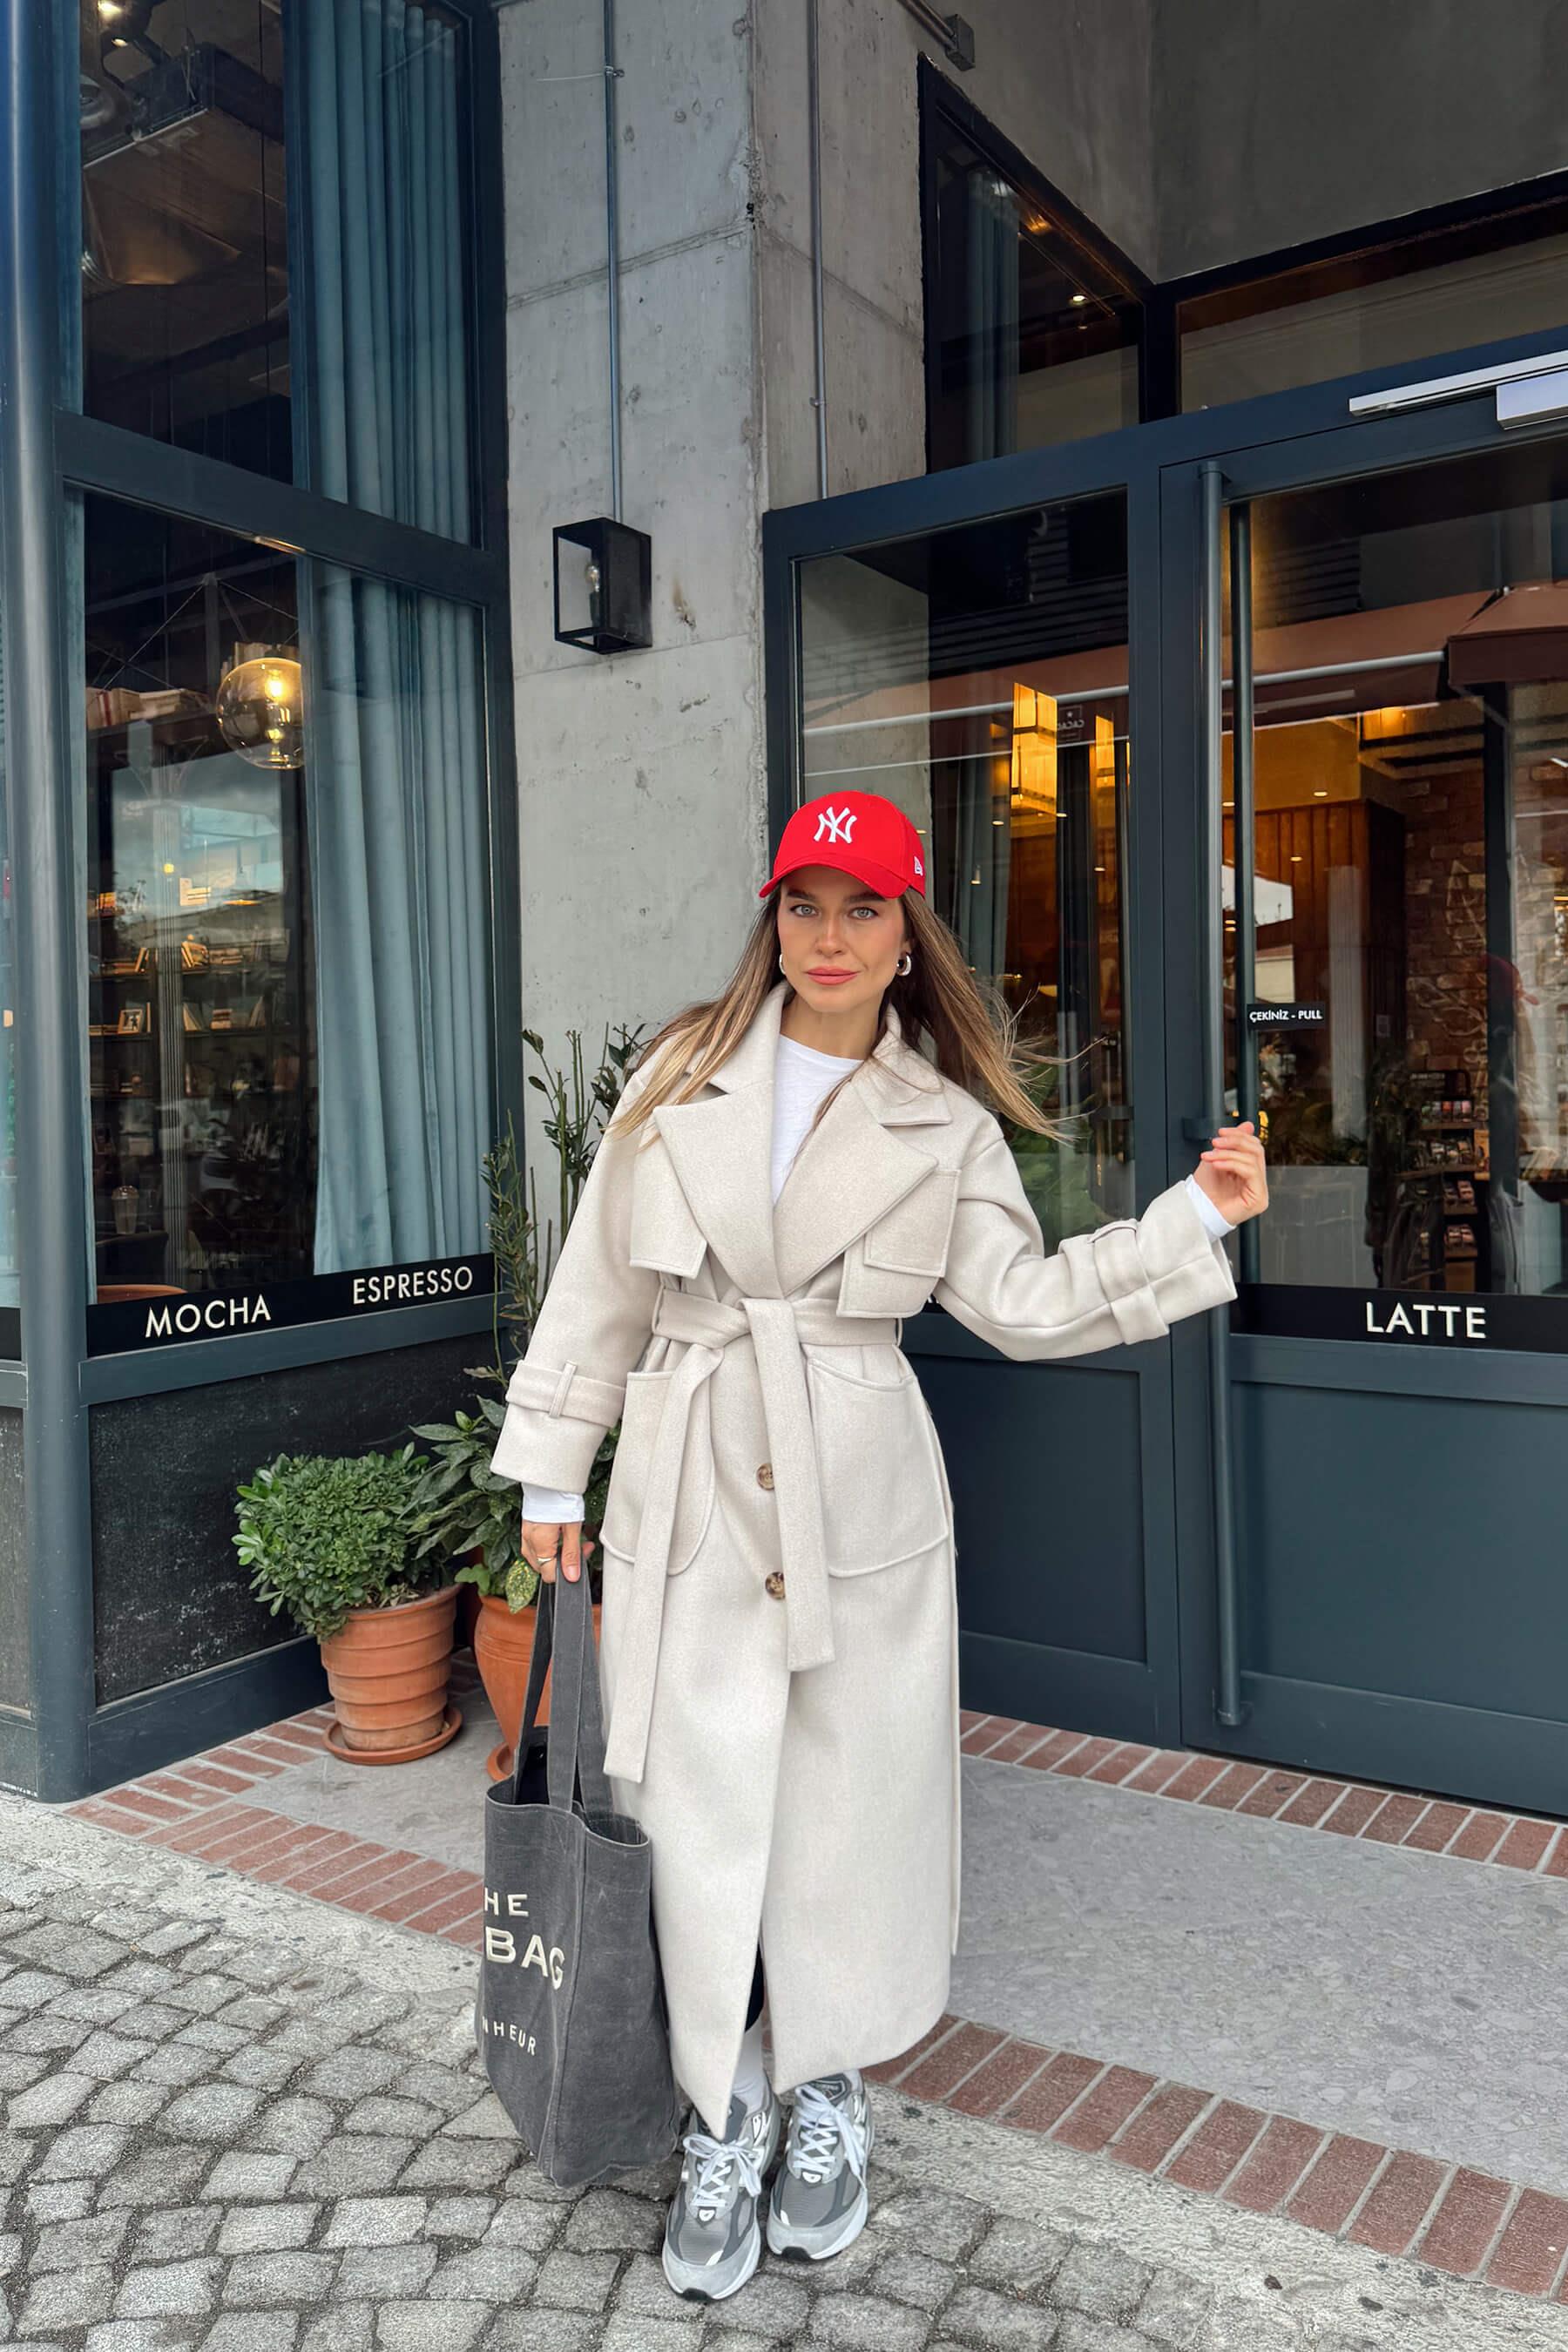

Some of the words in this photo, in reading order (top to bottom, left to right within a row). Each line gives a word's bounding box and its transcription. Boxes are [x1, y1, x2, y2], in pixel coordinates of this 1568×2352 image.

[814, 806, 858, 844] NY
[1298, 1010, 1323, 1020] PULL
[353, 1266, 473, 1305] ESPRESSO
[145, 1294, 272, 1338] MOCHA
[1366, 1301, 1486, 1339] LATTE
[485, 1926, 565, 1990] BAG
